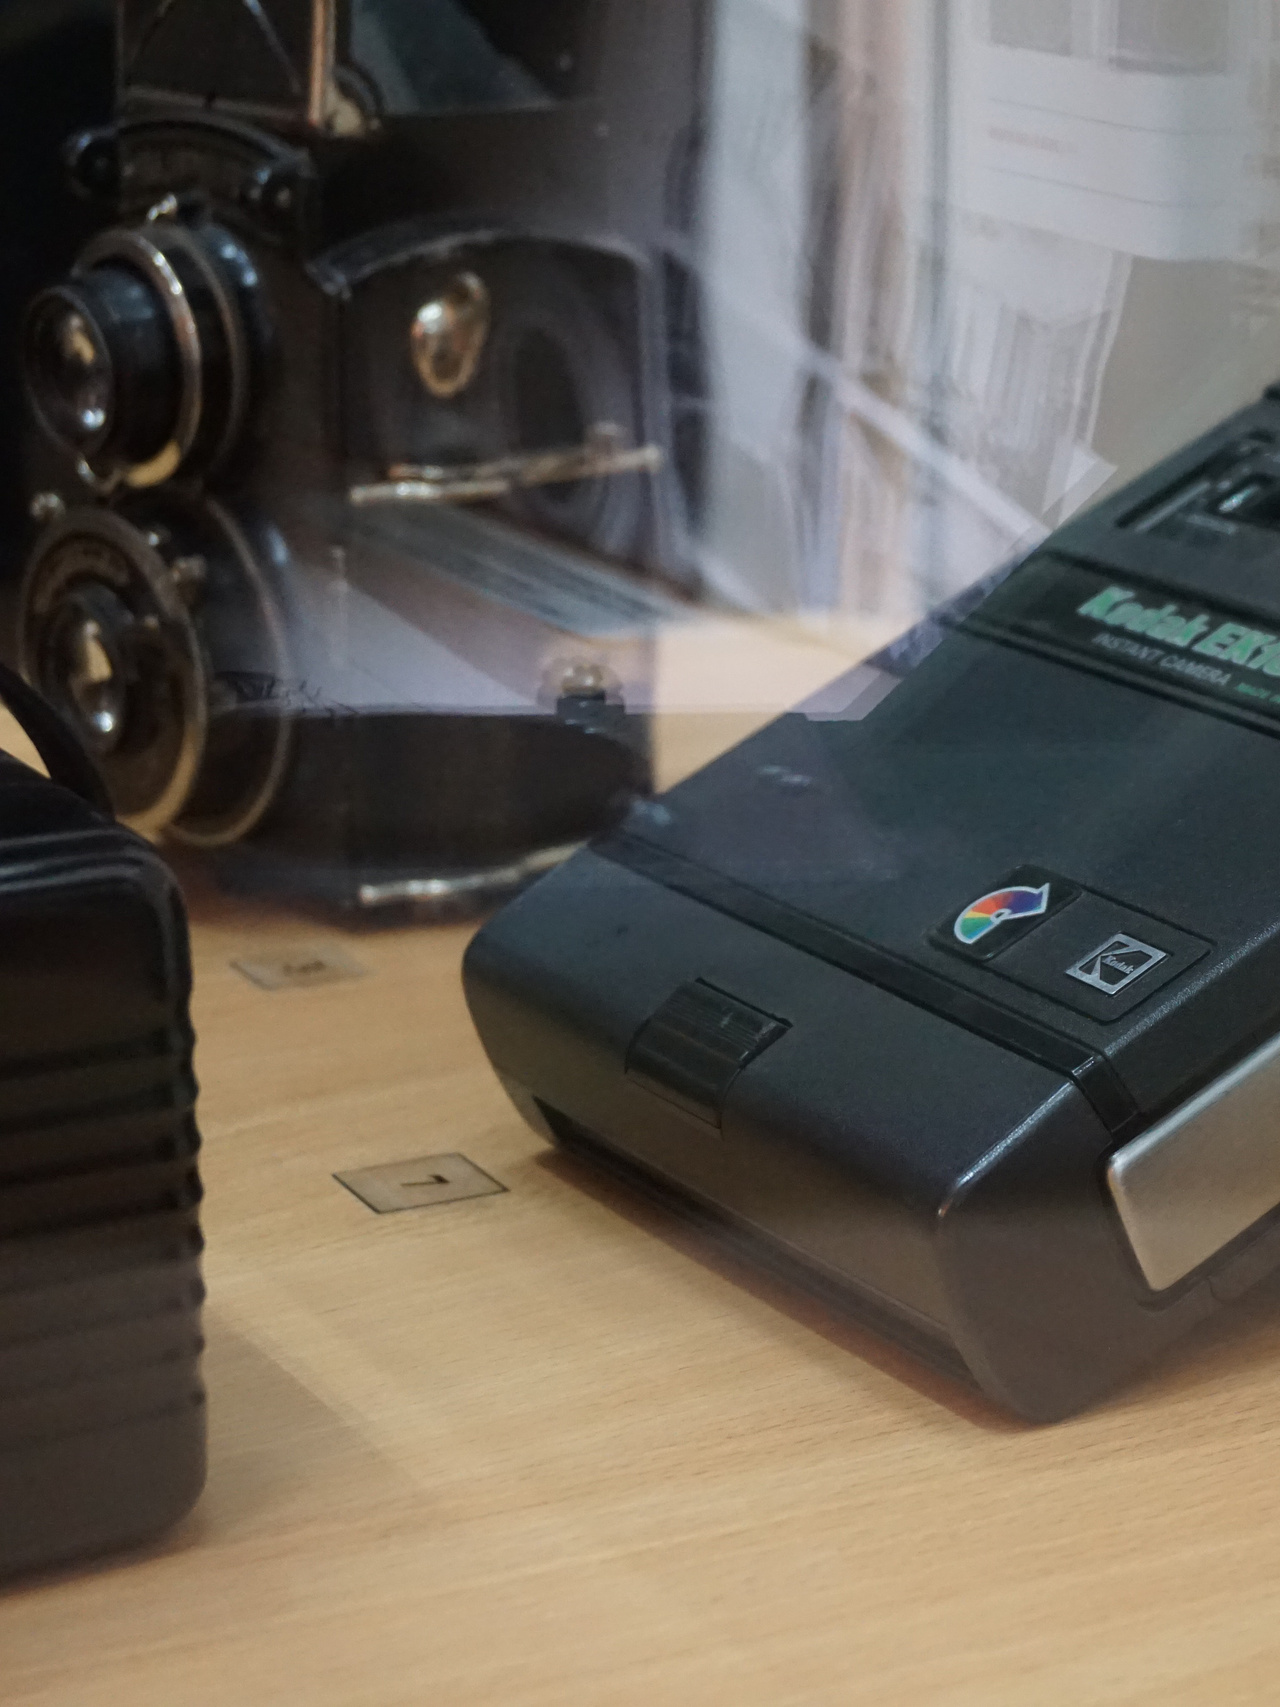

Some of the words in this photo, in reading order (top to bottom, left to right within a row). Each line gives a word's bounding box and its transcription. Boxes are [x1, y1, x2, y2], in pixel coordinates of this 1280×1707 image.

[1077, 586, 1208, 647] Kodak
[1091, 633, 1164, 661] INSTANT
[1160, 655, 1232, 686] CAMERA
[1102, 955, 1134, 974] Kodak
